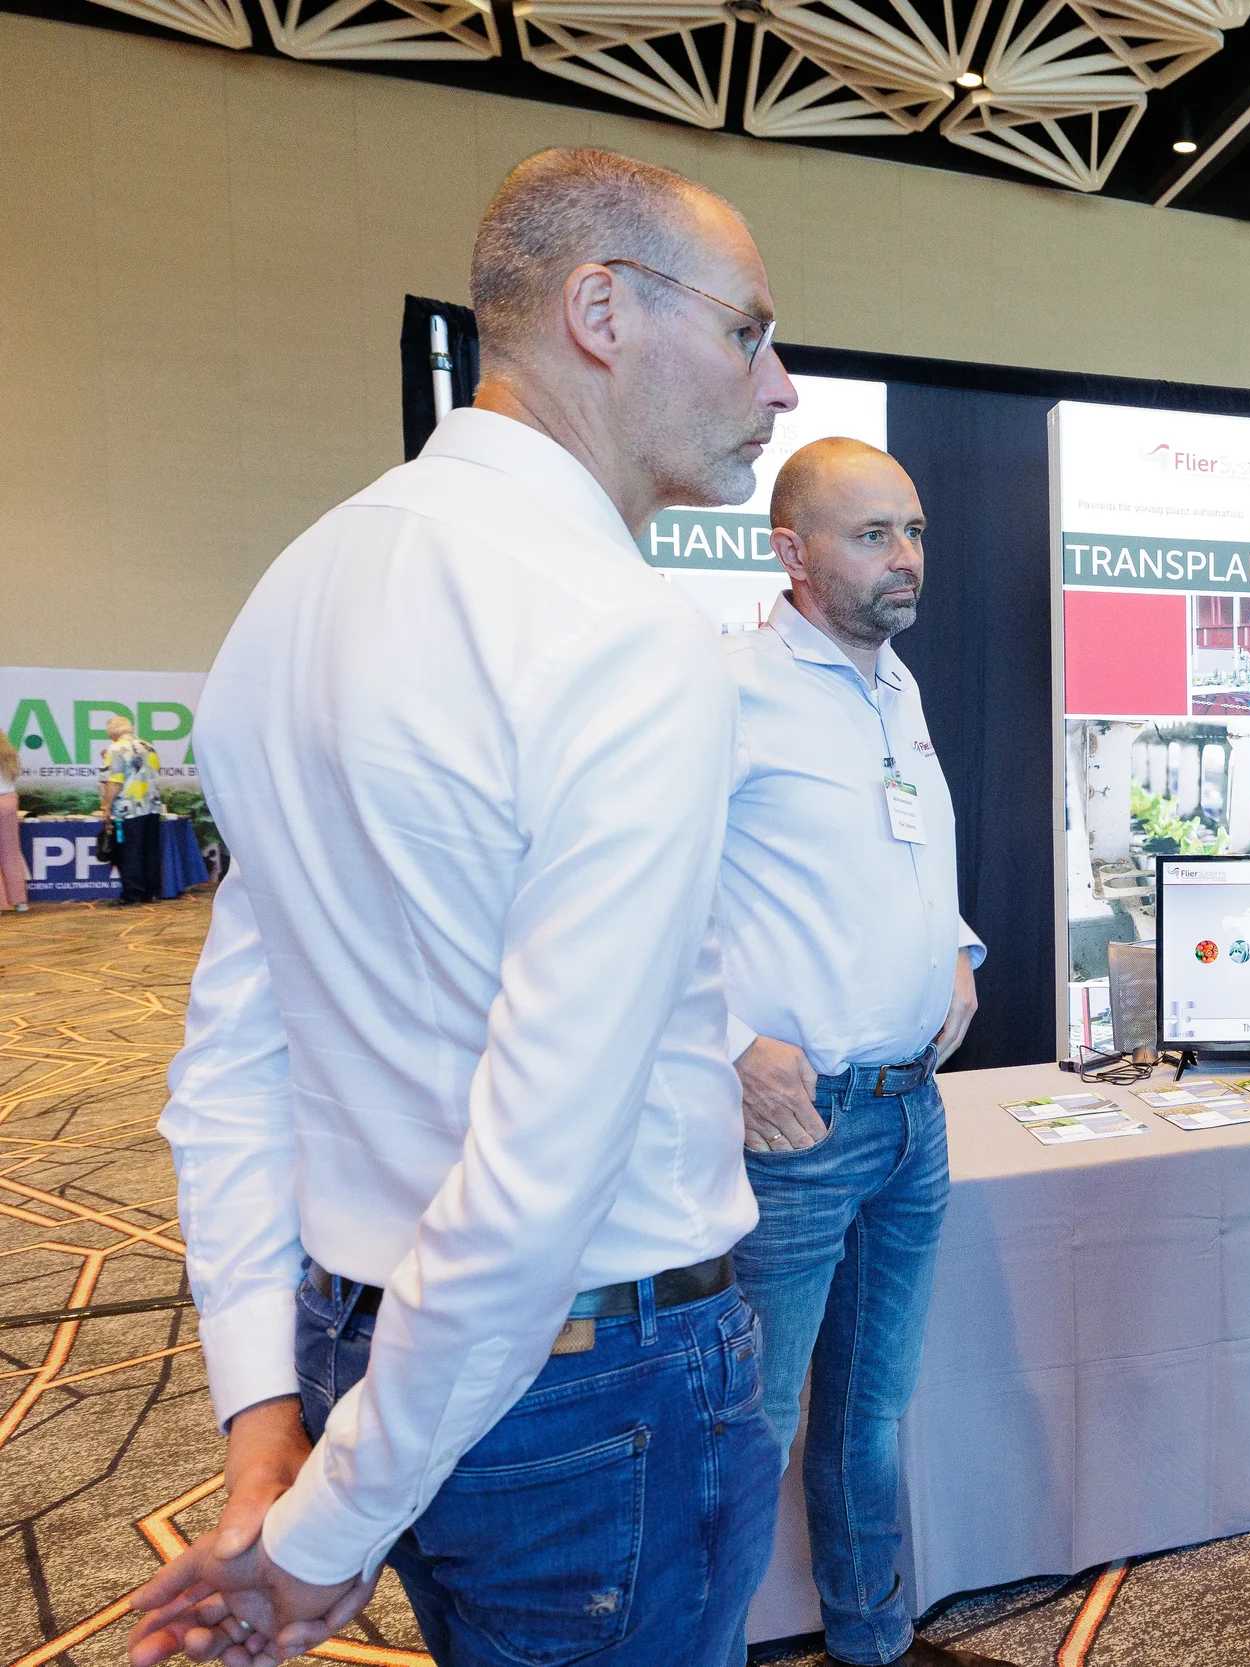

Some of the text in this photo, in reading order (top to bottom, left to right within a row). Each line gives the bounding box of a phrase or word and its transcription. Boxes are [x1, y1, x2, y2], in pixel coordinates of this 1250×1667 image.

[1174, 452, 1218, 473] Flier
[1078, 499, 1245, 519] Passion for young plant automation
[650, 521, 778, 561] HAND
[7, 699, 195, 764] APP
[1180, 870, 1198, 878] Flier
